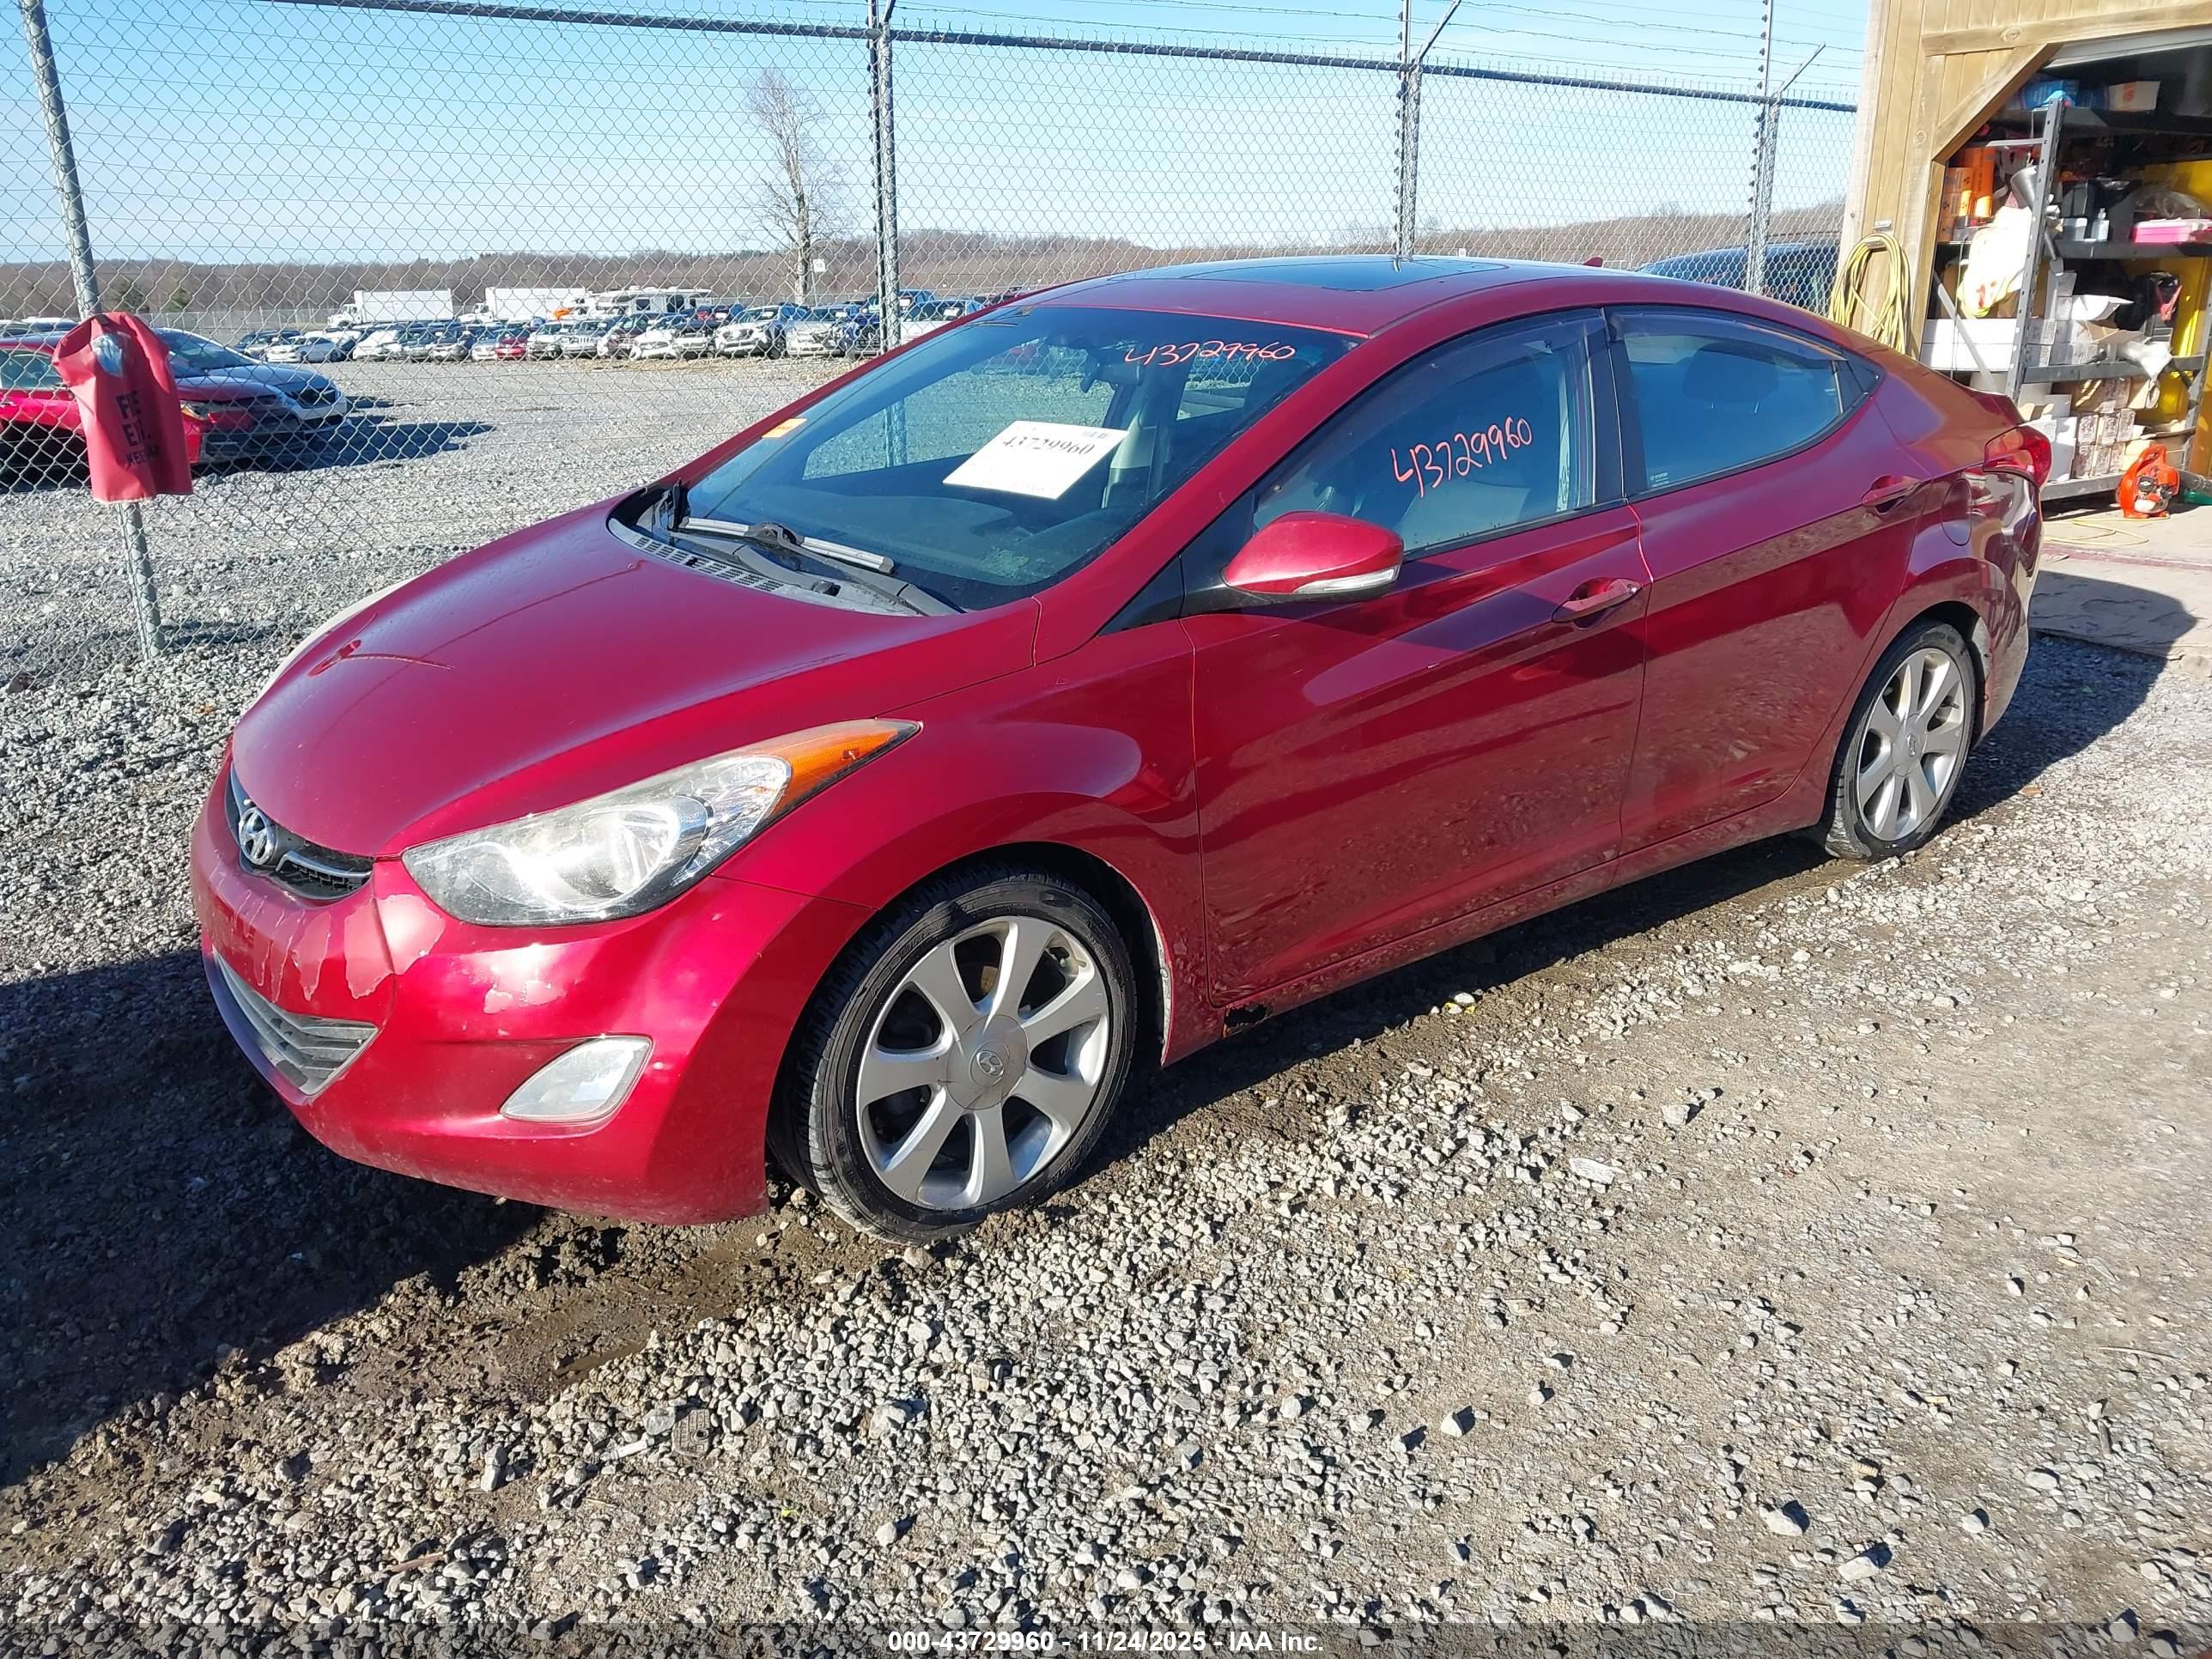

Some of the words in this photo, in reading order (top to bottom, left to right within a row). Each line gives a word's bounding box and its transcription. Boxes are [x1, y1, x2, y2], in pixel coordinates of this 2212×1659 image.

[1124, 341, 1296, 366] 43729960
[1002, 435, 1096, 455] 43729960
[1390, 416, 1533, 498] 43729960
